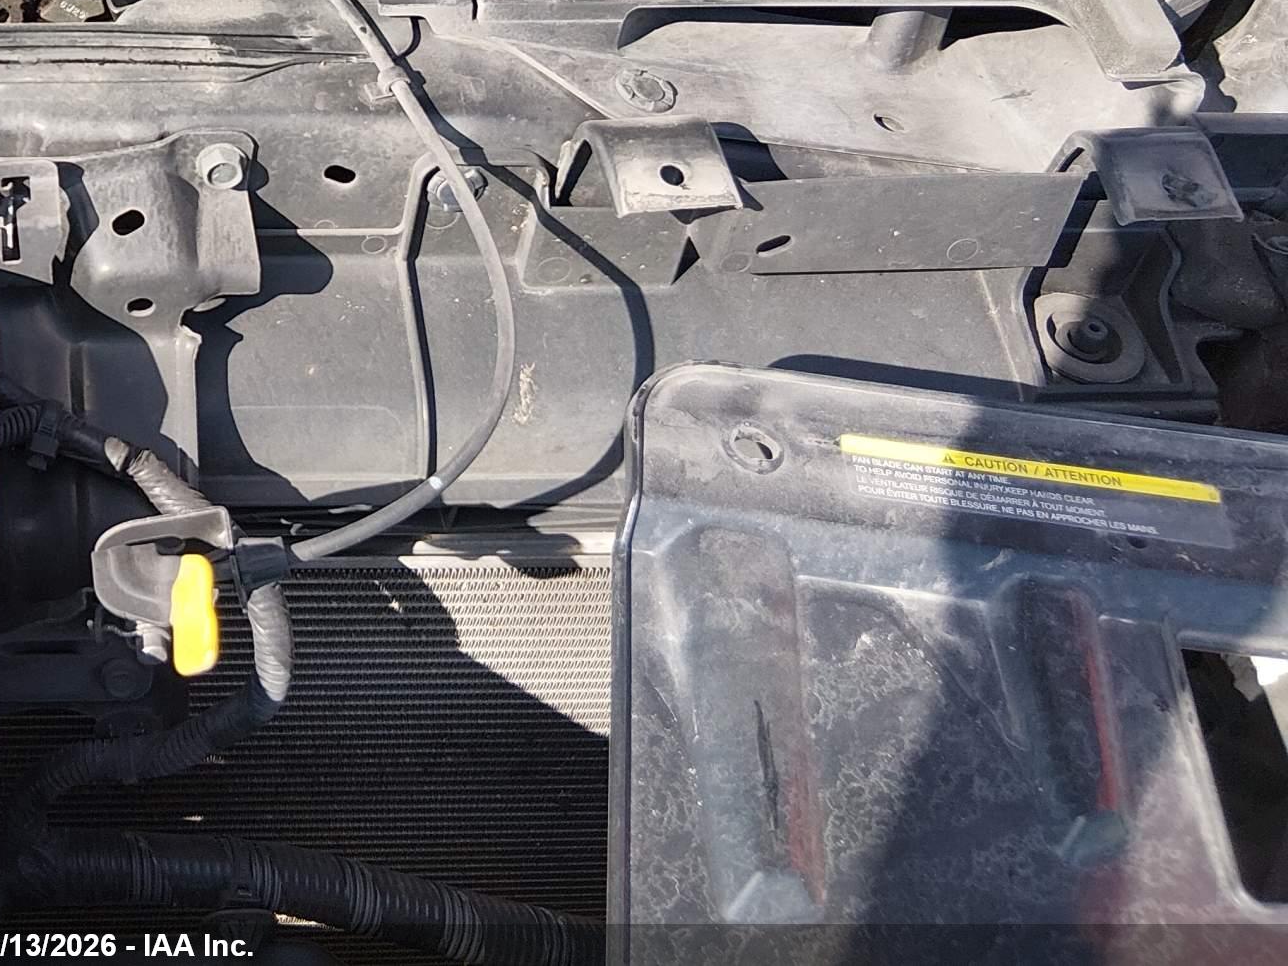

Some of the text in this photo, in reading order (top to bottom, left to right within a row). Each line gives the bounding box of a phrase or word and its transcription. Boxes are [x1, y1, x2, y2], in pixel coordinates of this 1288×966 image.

[852, 455, 871, 466] FAN
[871, 458, 903, 470] BLADE
[903, 462, 924, 472] CAN
[924, 464, 954, 477] START
[954, 469, 966, 478] AT
[967, 470, 986, 483] ANY
[853, 464, 867, 474] TO
[868, 466, 894, 477] HELP
[894, 469, 922, 482] AVOID
[923, 473, 973, 488] PERSONAL
[964, 455, 1123, 487] CAUTION / ATTENTION
[856, 475, 869, 484] LE
[870, 477, 929, 492] VENTILATEUR
[929, 486, 964, 499] RISQUE
[965, 491, 979, 500] DE
[980, 491, 1031, 507] DÉMARRER
[1041, 501, 1063, 511] TOUT
[859, 484, 886, 496] POUR
[886, 486, 918, 501] ÉVITER
[919, 493, 950, 506] TOUTE
[1001, 505, 1015, 515] NE
[1016, 507, 1035, 519] PAS
[1036, 511, 1050, 520] EN
[1050, 513, 1108, 528] APPROCHER
[1109, 520, 1127, 531] LES
